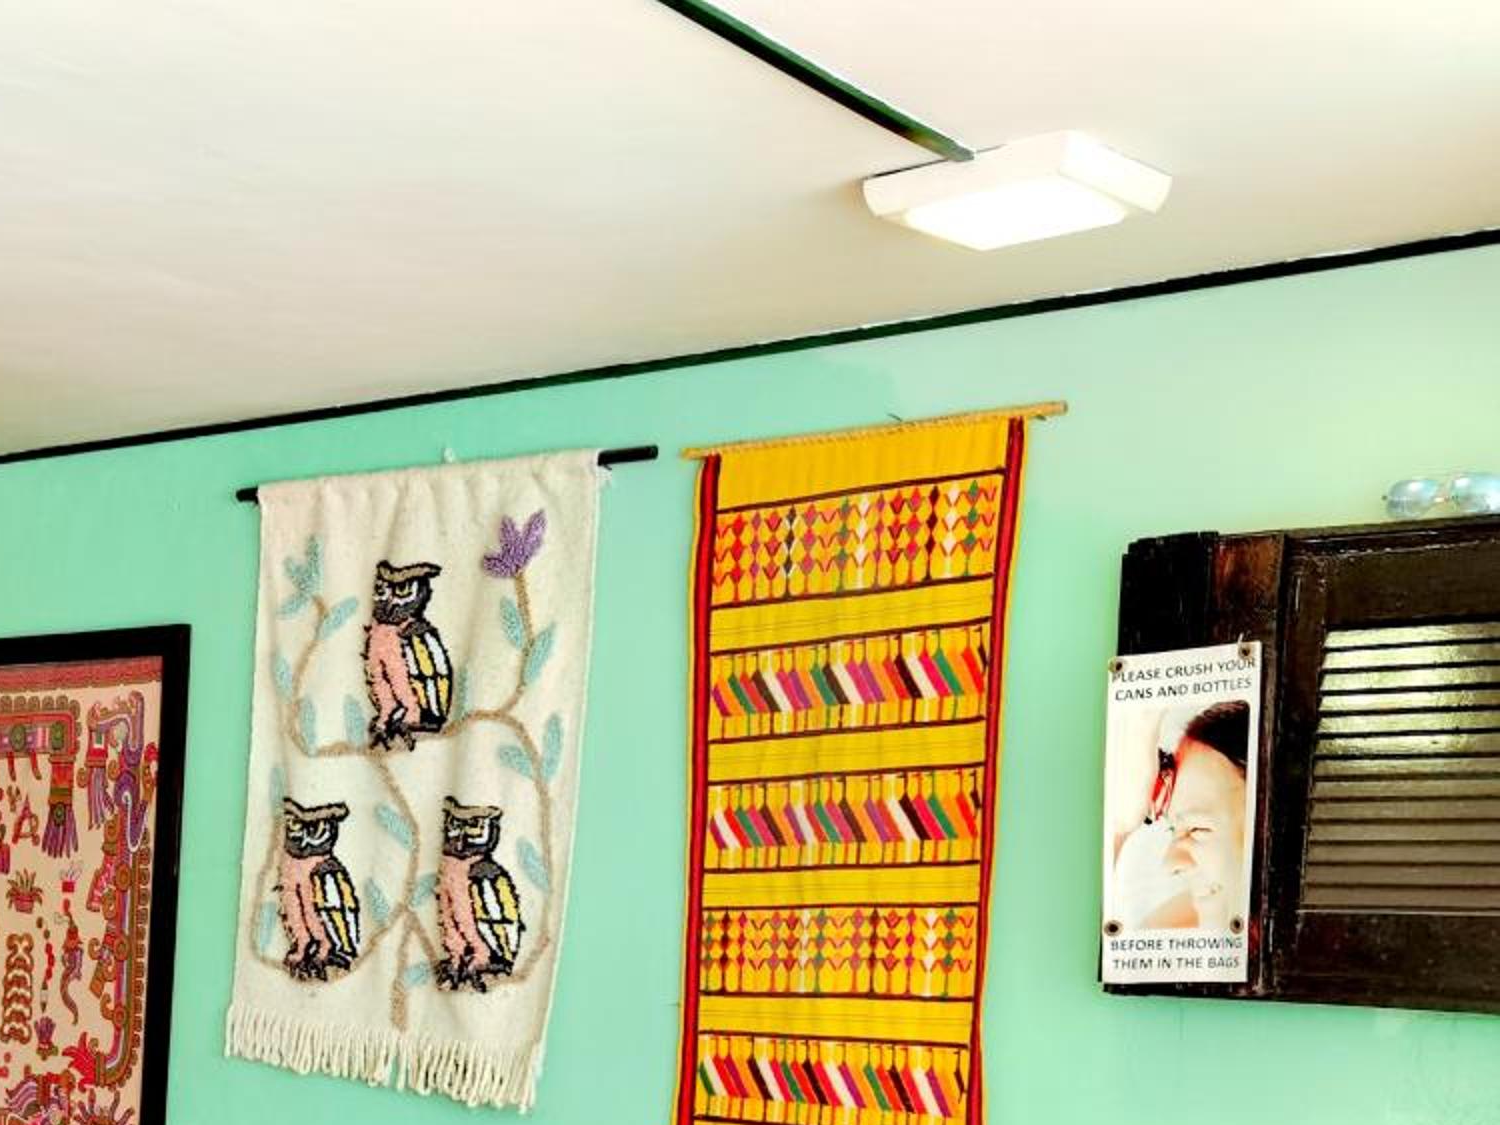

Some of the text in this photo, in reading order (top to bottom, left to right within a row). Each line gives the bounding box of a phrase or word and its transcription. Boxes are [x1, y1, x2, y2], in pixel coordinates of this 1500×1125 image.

[1111, 658, 1256, 683] PLEASE CRUSH YOUR
[1115, 677, 1252, 701] CANS AND BOTTLES
[1110, 937, 1243, 951] BEFORE THROWING
[1113, 956, 1240, 970] THEM IN THE BAGS
